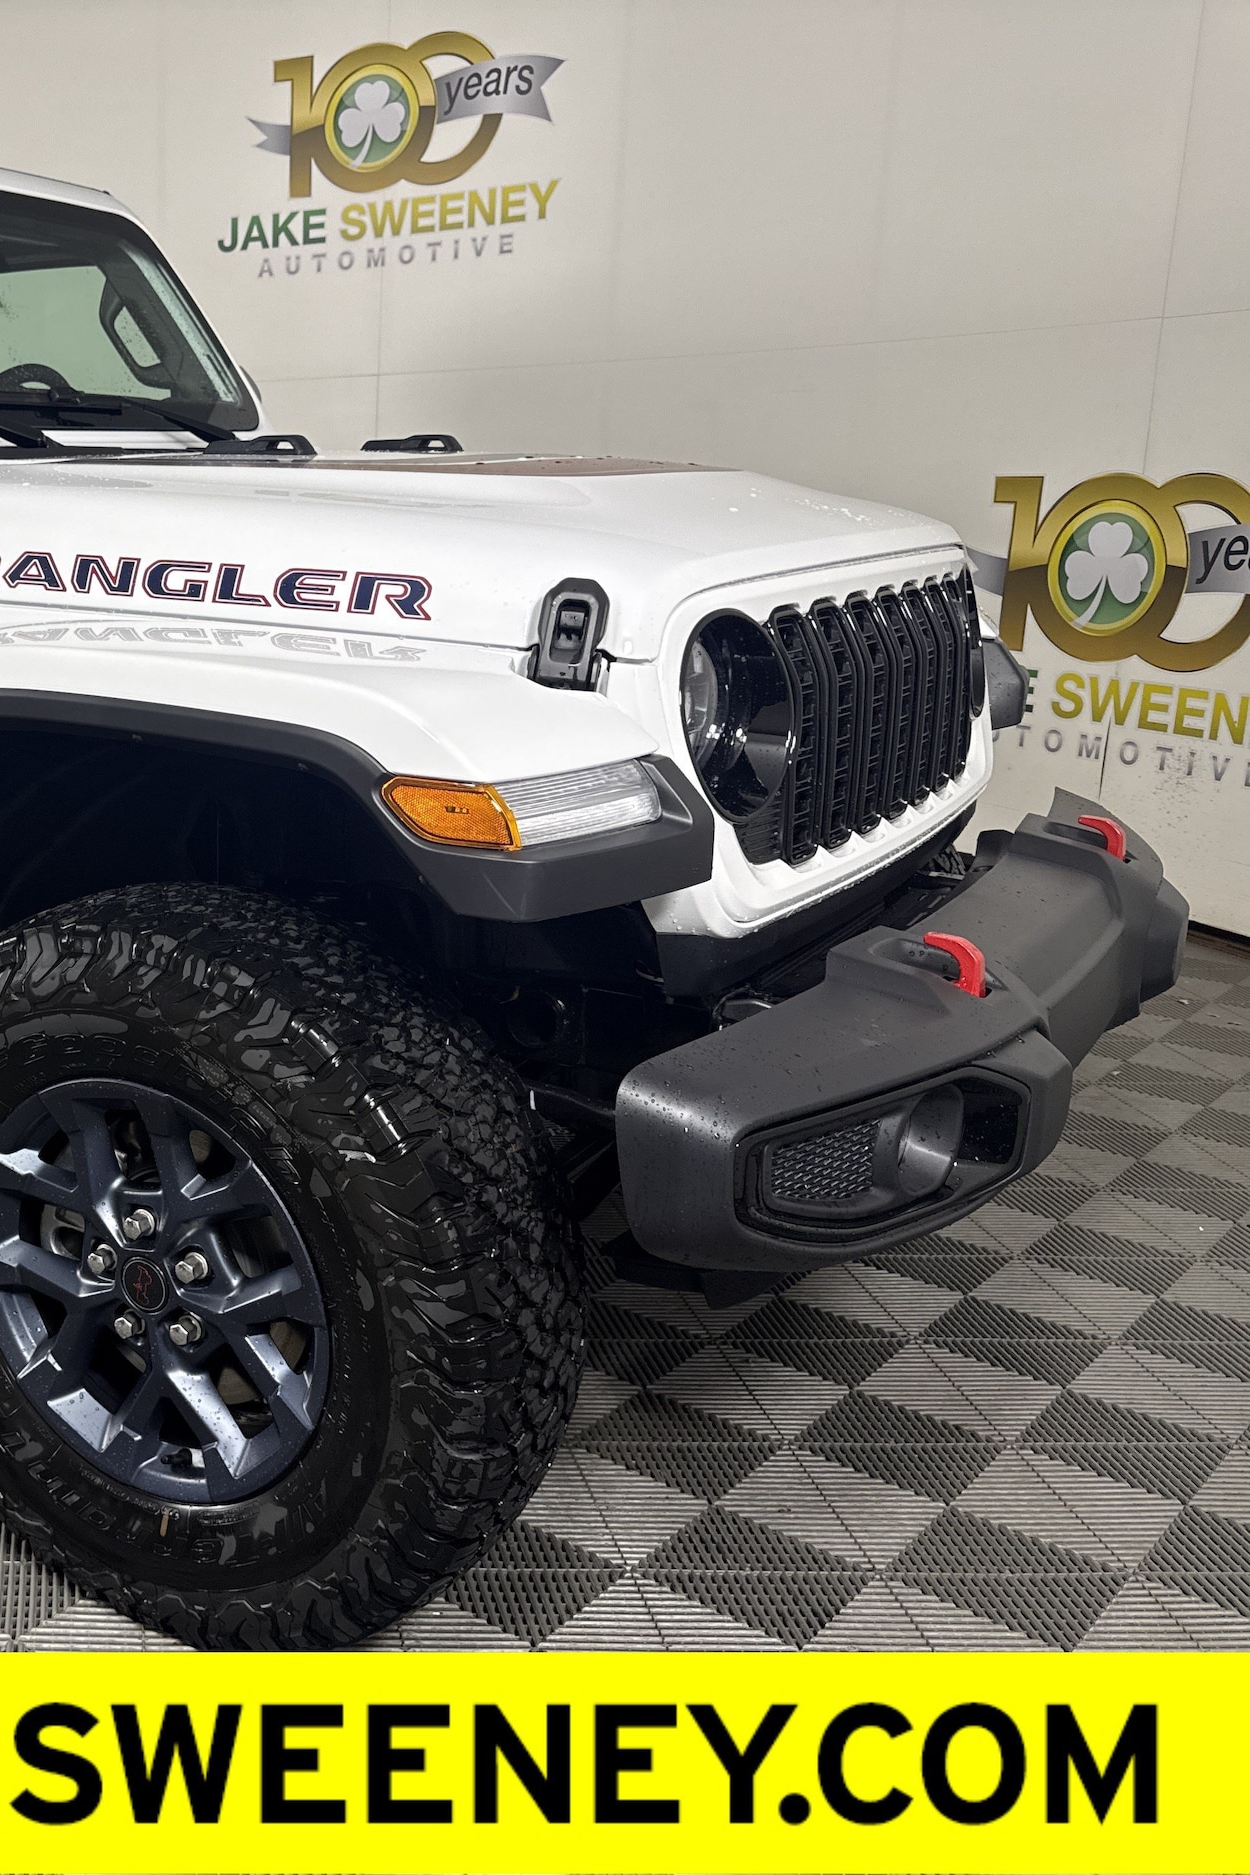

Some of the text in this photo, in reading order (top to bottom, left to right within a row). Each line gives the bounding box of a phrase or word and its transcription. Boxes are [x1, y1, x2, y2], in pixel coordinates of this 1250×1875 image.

[273, 31, 535, 198] 100 years
[217, 179, 560, 252] JAKE SWEENEY
[258, 234, 514, 278] AUTOMOTIVE
[994, 472, 1250, 672] 100
[1052, 672, 1250, 745] SWEEN
